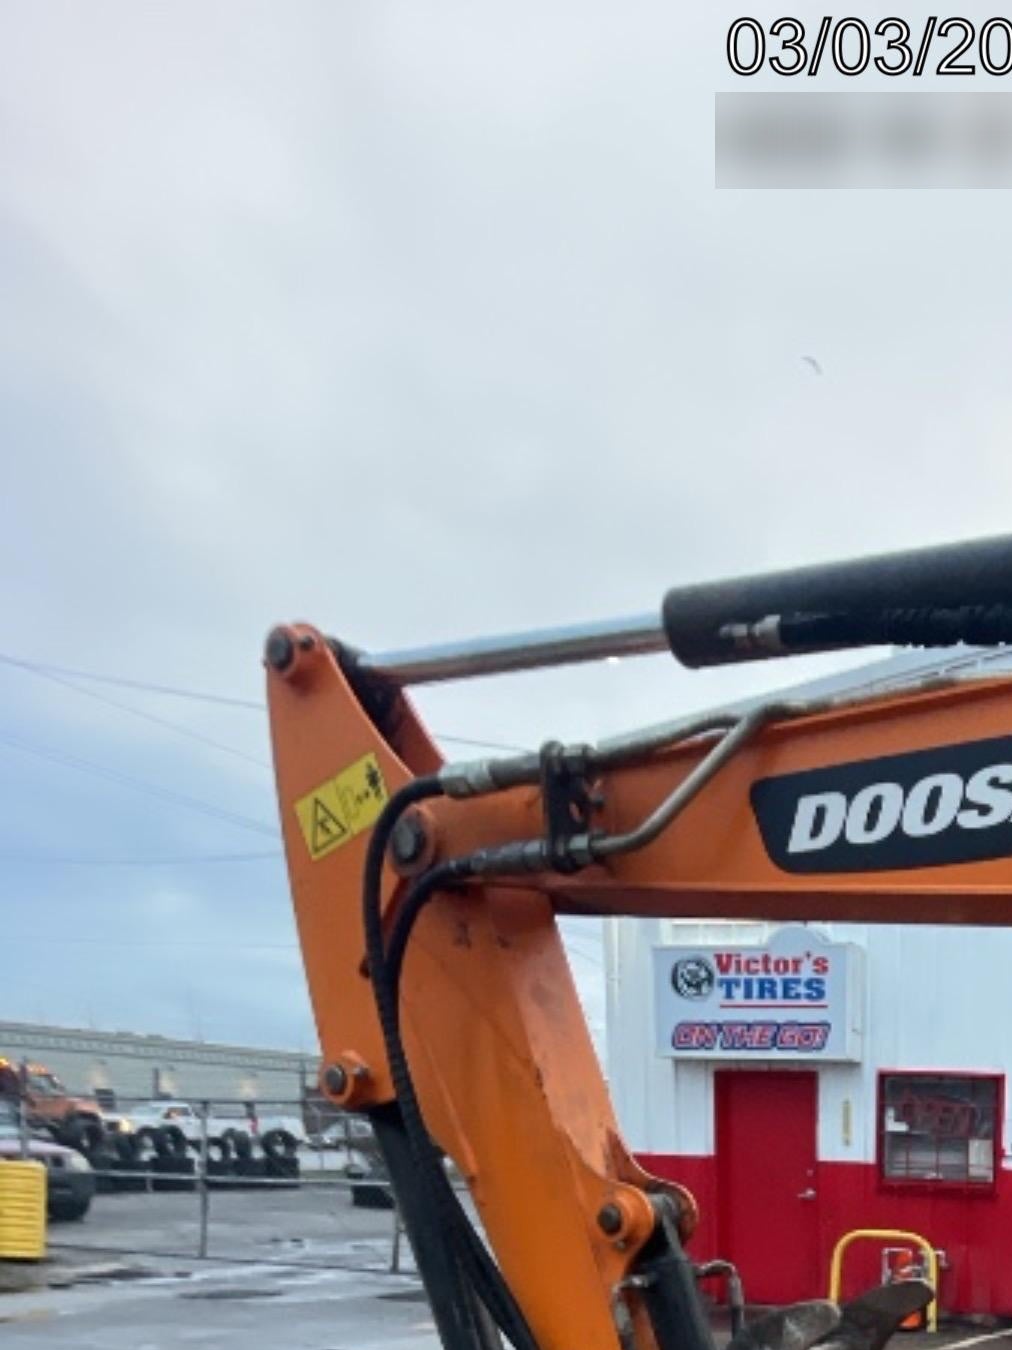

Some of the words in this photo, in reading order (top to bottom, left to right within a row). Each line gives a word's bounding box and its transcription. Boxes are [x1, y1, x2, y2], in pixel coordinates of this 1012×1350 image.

[714, 953, 829, 975] Victor's
[718, 978, 826, 1000] TIRES
[674, 1021, 721, 1050] ON
[721, 1021, 777, 1050] THE
